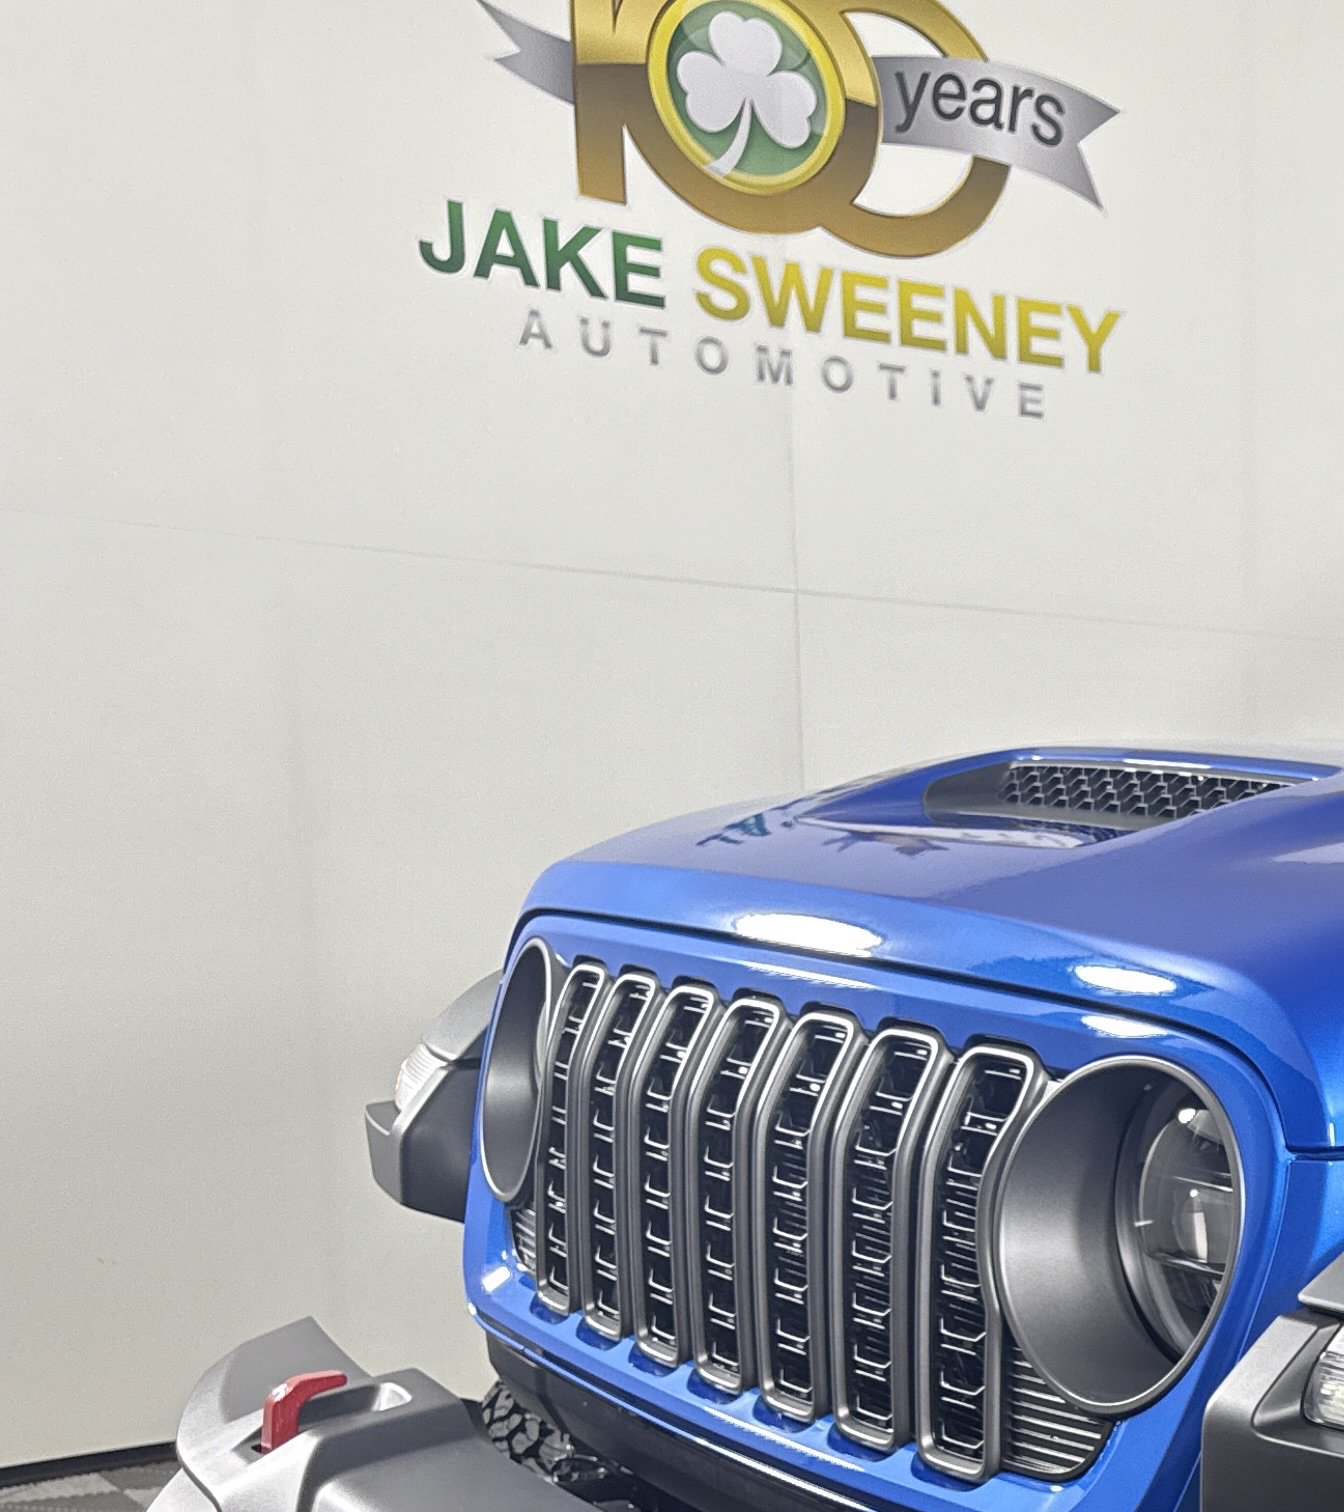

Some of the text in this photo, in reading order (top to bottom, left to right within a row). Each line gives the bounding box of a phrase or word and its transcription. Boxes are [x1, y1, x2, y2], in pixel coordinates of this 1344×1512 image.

[569, 0, 1066, 258] 100 years
[419, 200, 1121, 374] JAKE SWEENEY
[518, 309, 1045, 420] AUTOMOTIVE
